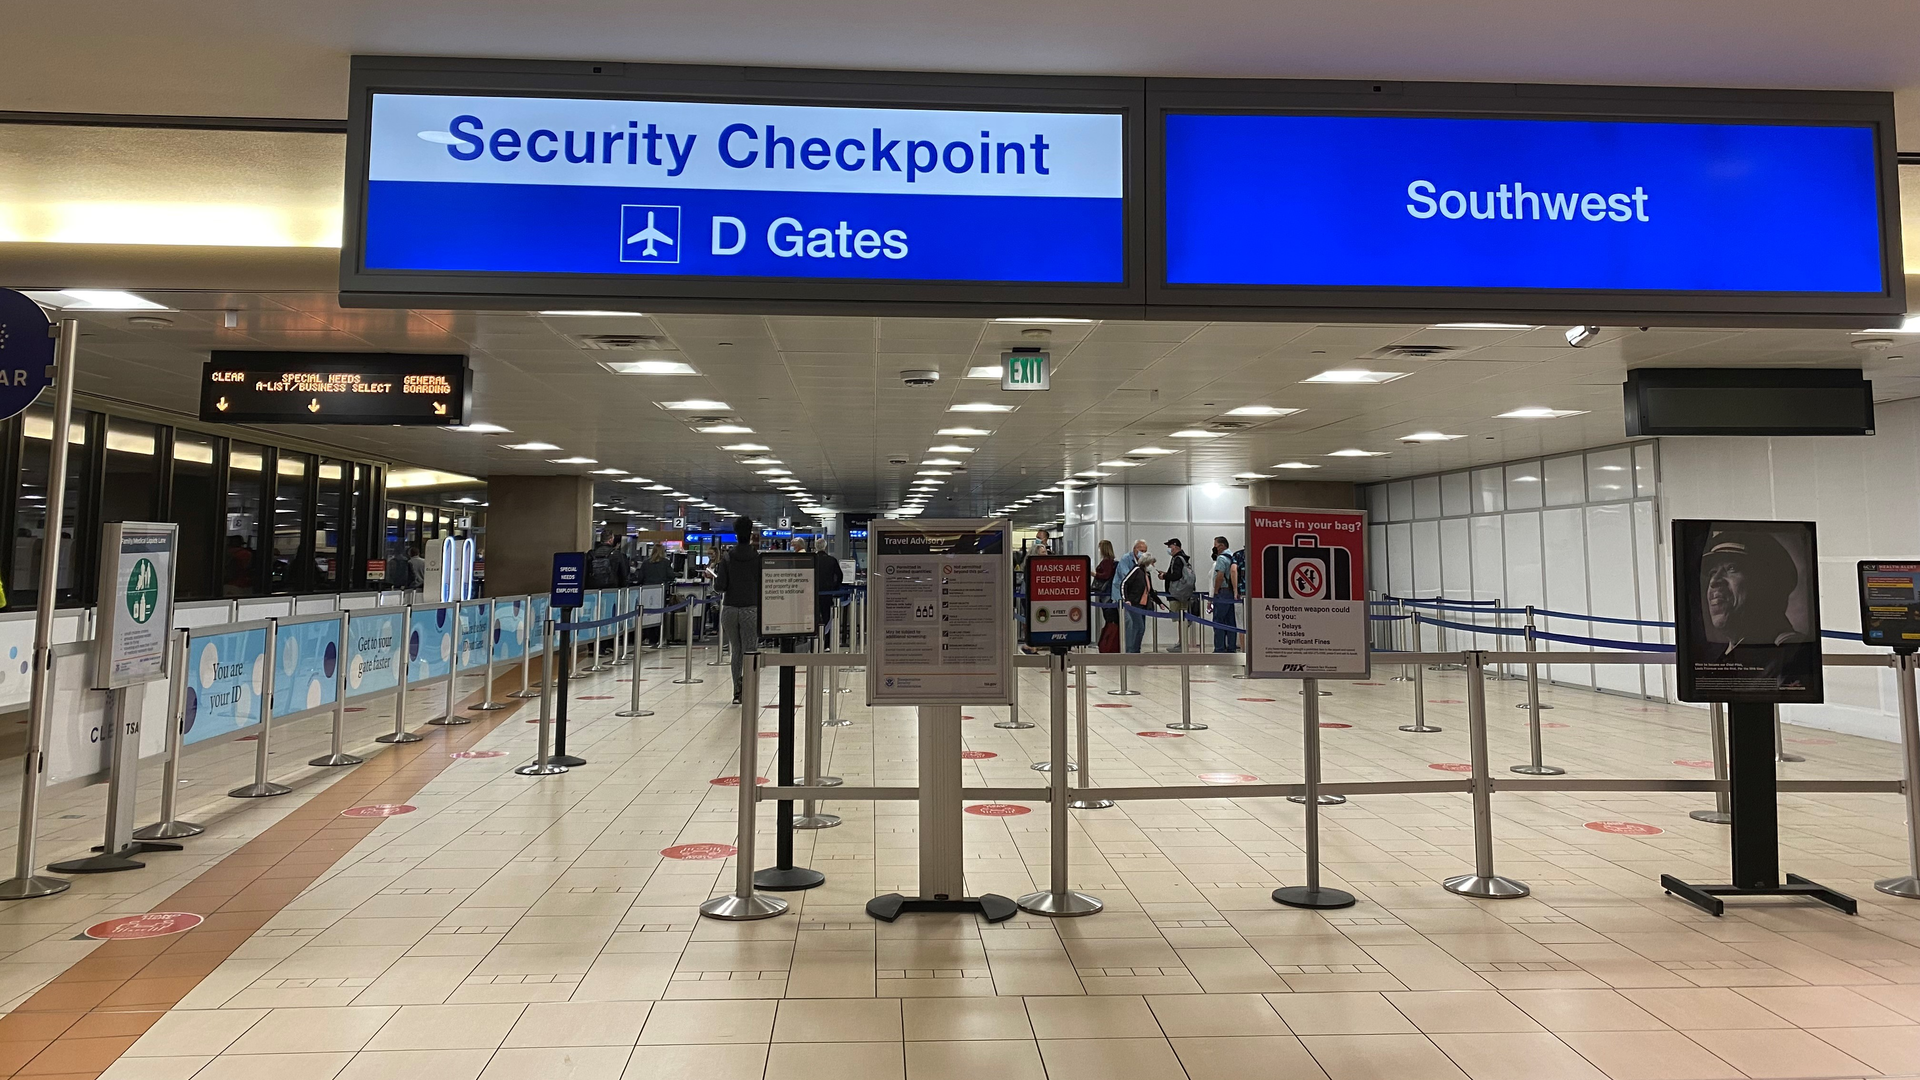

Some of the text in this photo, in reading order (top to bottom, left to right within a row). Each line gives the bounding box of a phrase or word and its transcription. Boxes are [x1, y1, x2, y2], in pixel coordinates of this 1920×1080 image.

[447, 114, 1051, 184] Security Checkpoint
[1406, 179, 1649, 222] Southwest
[711, 216, 909, 260] D Gates
[212, 372, 245, 382] CLEAR
[1009, 357, 1044, 384] EXIT
[282, 373, 361, 384] SPECIAL NEEDS
[404, 375, 449, 386] GENERAL
[256, 381, 392, 393] A-LIST/BUSINESS SELECT
[403, 384, 451, 394] BOARDING
[461, 519, 467, 527] 1
[676, 519, 682, 527] 2
[781, 519, 787, 527] 3
[1254, 518, 1362, 532] What's in your bag?
[884, 537, 945, 546] Travel Advisory
[1272, 605, 1302, 613] forgotten
[358, 636, 392, 653] Get to your
[213, 663, 244, 680] You are
[358, 656, 391, 678] gate faster
[209, 685, 242, 714] your ID
[90, 724, 114, 743] CLE
[126, 722, 139, 735] TSA
